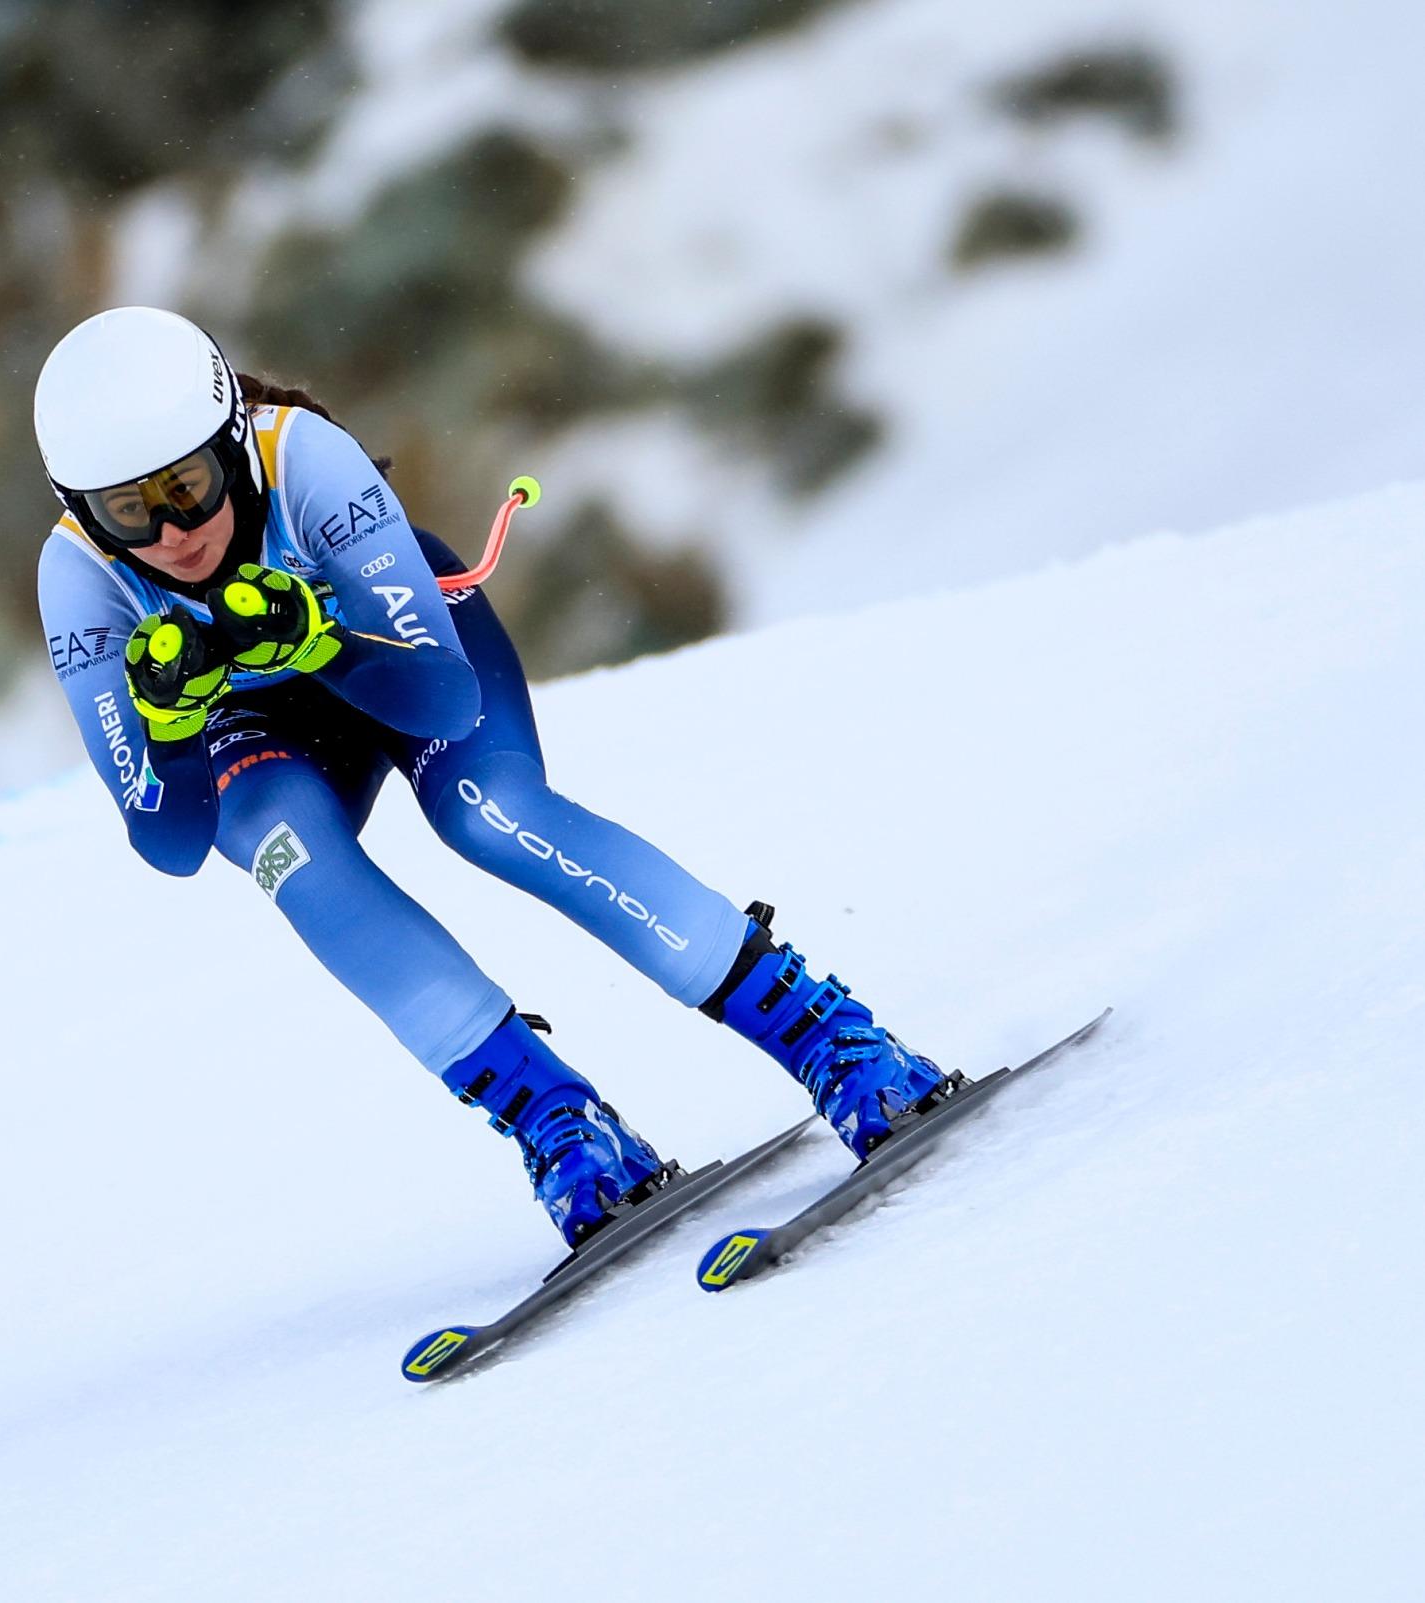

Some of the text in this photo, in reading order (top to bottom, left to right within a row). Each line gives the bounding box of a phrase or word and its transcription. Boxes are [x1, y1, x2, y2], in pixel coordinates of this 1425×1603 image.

[209, 348, 224, 404] uvex
[255, 830, 299, 898] ORST
[457, 778, 690, 952] PIQUADRO
